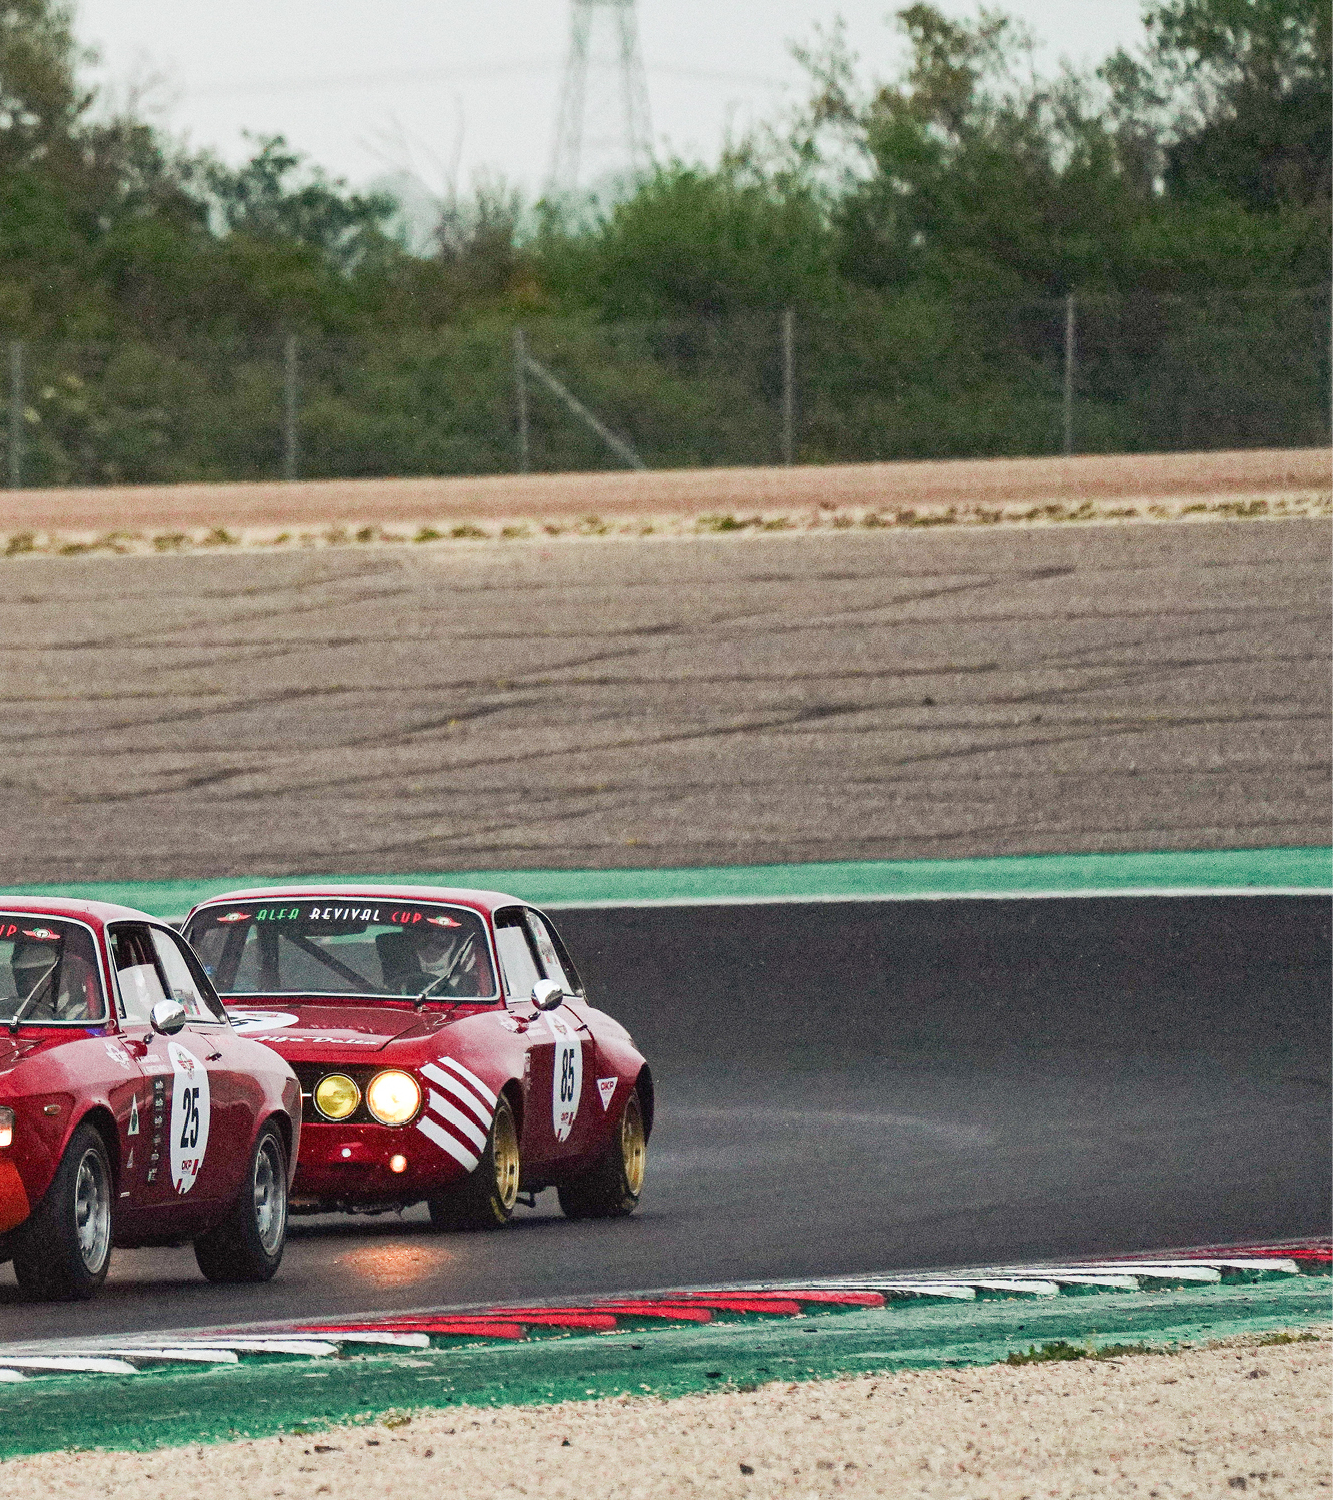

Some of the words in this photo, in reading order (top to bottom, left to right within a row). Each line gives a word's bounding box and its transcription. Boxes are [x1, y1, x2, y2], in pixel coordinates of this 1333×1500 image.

[256, 908, 300, 921] ALFA
[309, 907, 380, 922] REVIVAL
[391, 911, 422, 924] CUP
[561, 1048, 575, 1102] 85
[180, 1087, 199, 1148] 25
